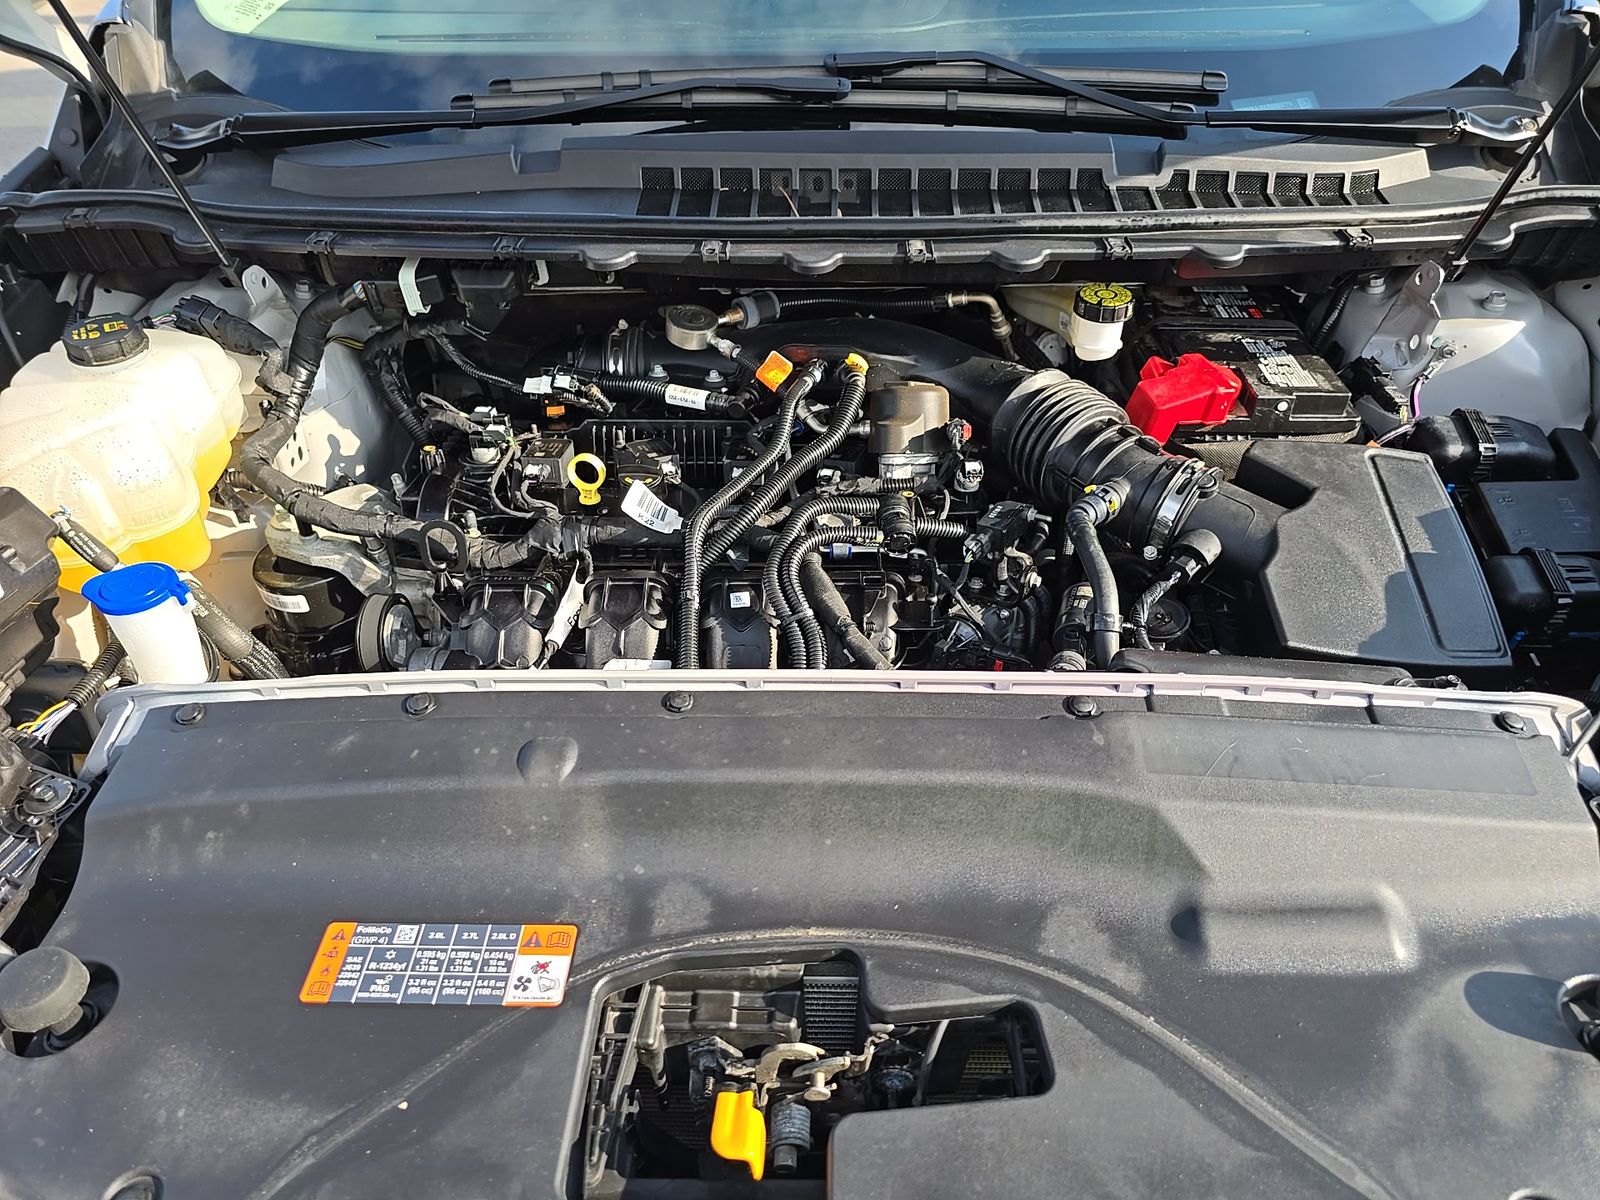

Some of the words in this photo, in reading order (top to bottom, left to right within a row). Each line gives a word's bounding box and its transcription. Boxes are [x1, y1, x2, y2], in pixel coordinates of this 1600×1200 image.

[355, 926, 393, 934] FoMoCo
[350, 936, 376, 945] (GWP
[436, 950, 447, 960] kg
[470, 951, 481, 961] kg
[503, 951, 515, 961] kg
[369, 984, 390, 993] PAG
